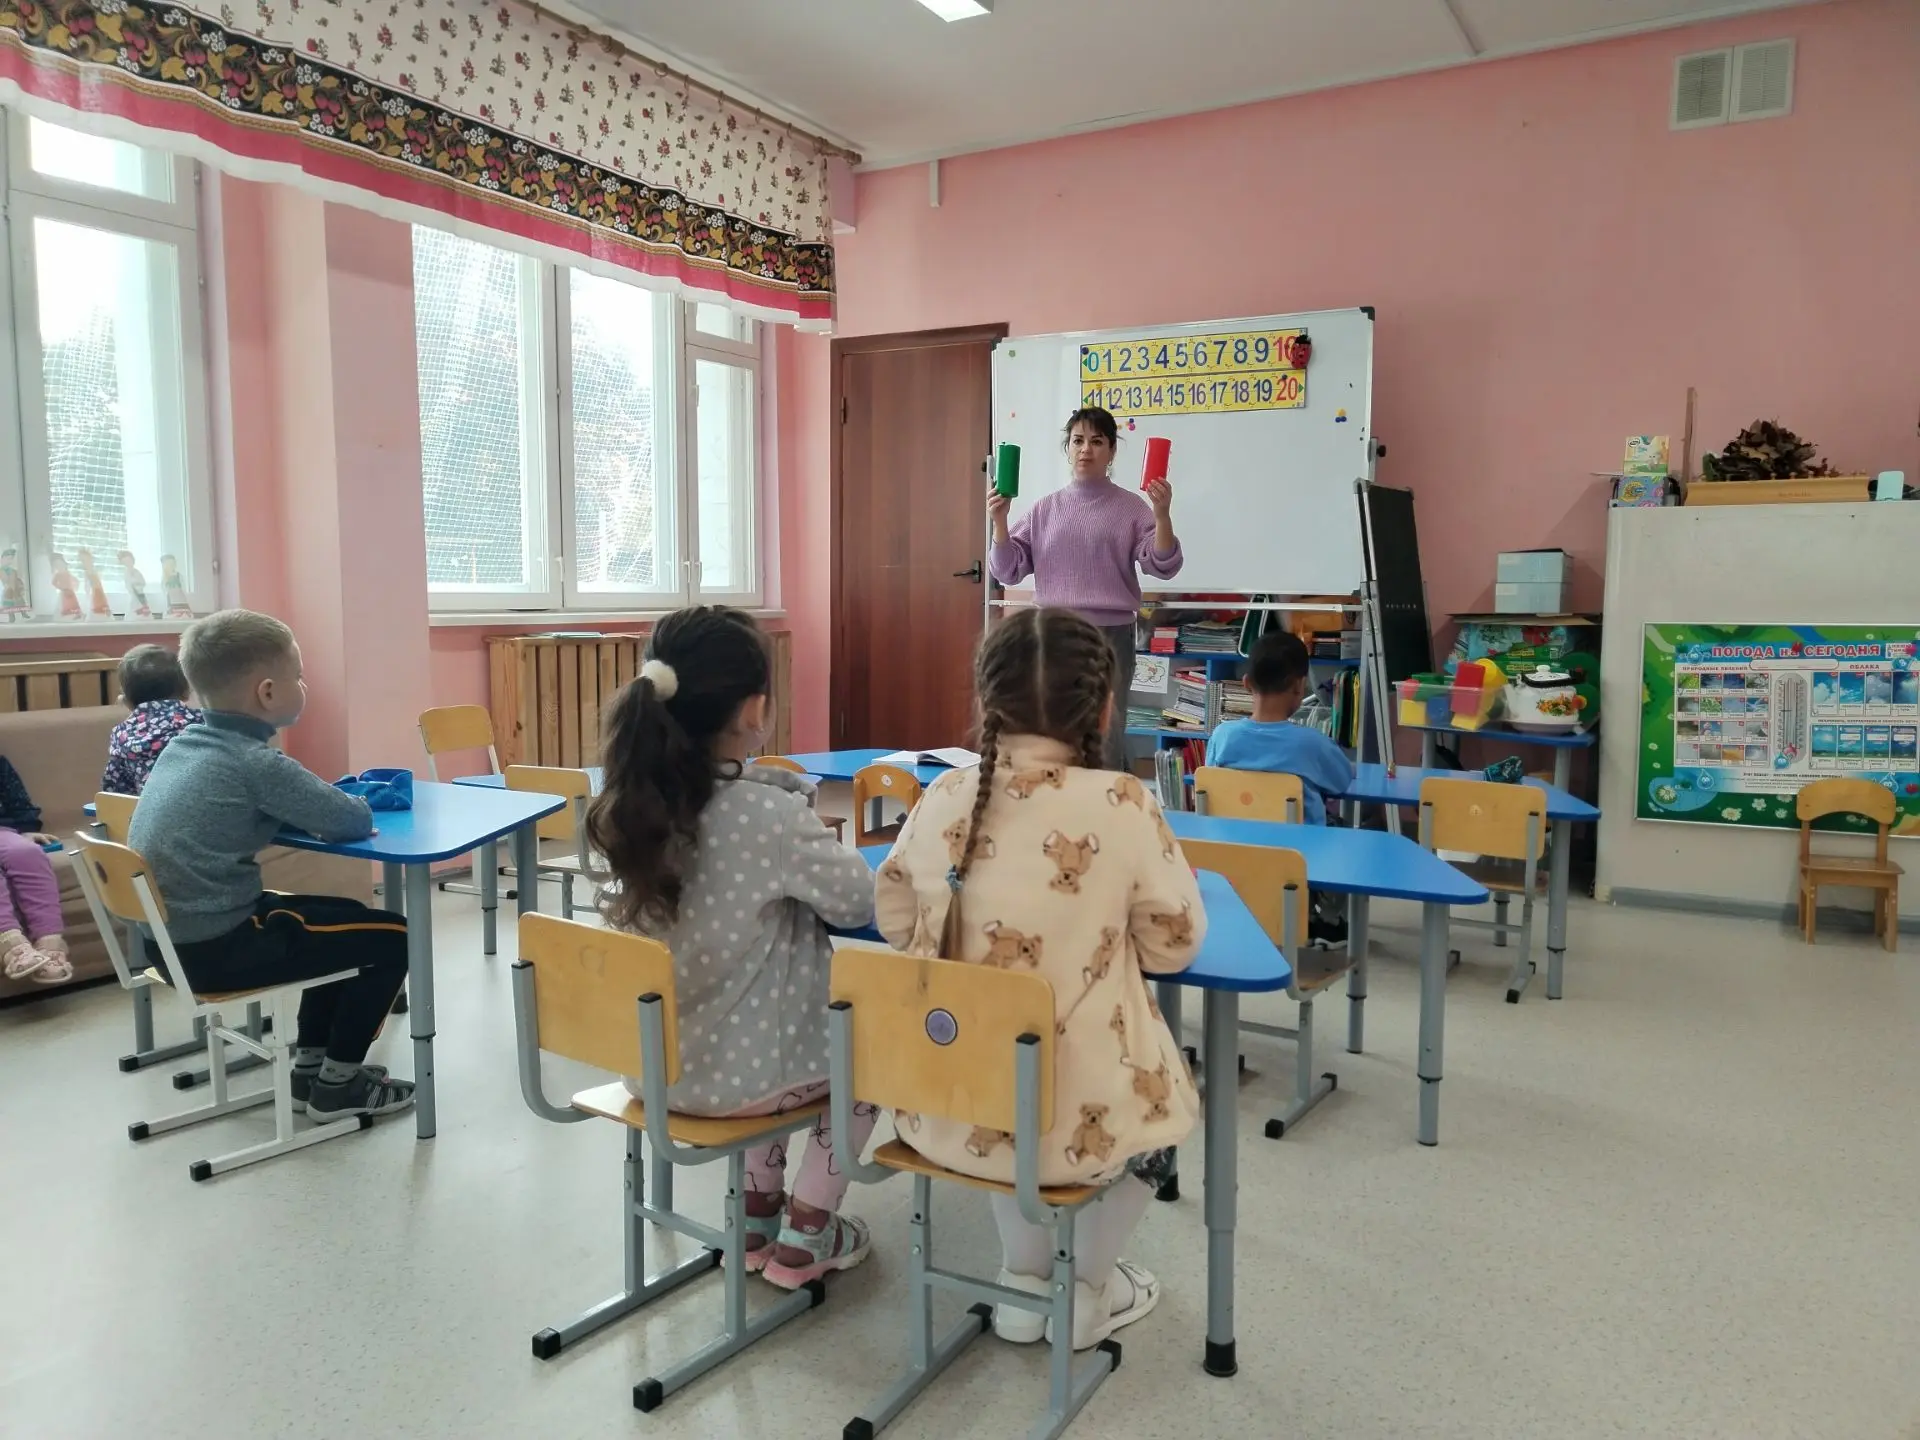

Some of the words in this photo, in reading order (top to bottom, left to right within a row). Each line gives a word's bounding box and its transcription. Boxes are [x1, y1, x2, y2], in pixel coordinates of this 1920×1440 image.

[1087, 352, 1099, 372] 0
[1102, 349, 1112, 372] 1
[1119, 347, 1132, 371] 2
[1137, 346, 1150, 370] 3
[1155, 344, 1169, 368] 4
[1175, 343, 1188, 367] 5
[1193, 341, 1207, 366] 6
[1213, 340, 1227, 364] 7
[1233, 339, 1248, 363] 8
[1254, 337, 1269, 362] 9
[1088, 388, 1103, 408] 11
[1106, 387, 1122, 409] 12
[1126, 386, 1142, 408] 13
[1146, 385, 1164, 407] 14
[1167, 384, 1185, 406] 15
[1188, 382, 1206, 405] 16
[1210, 381, 1228, 403] 17
[1231, 380, 1249, 403] 18
[1253, 378, 1272, 401] 19
[1275, 376, 1298, 400] 20
[1712, 646, 1774, 659] ПОГОДА
[1804, 645, 1881, 658] СЕГОДНЯ
